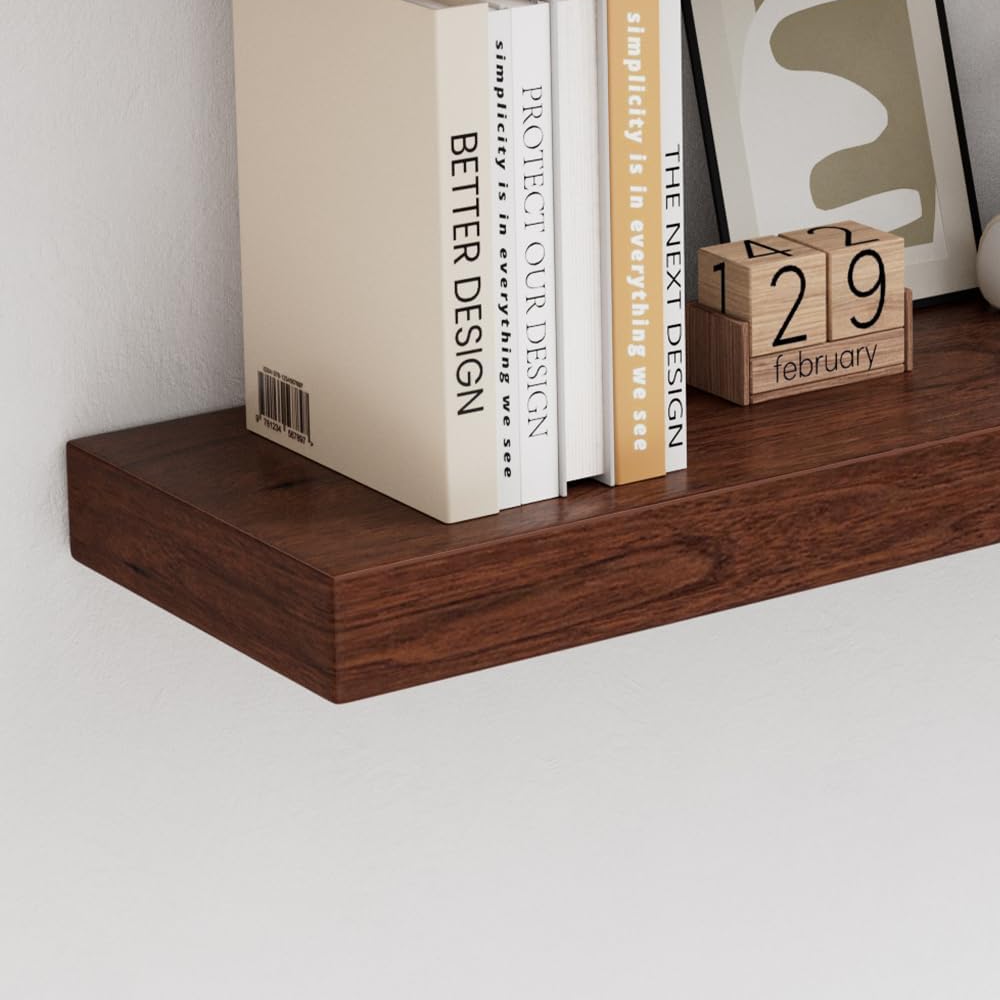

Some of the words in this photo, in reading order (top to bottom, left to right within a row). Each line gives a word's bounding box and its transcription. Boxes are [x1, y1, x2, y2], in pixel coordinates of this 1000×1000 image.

[494, 40, 507, 170] simplicity
[624, 12, 646, 143] simplicity
[498, 181, 508, 201] is
[522, 86, 546, 233] PROTECT
[629, 153, 648, 175] is
[665, 144, 681, 210] THE
[450, 132, 481, 265] BETTER
[499, 213, 509, 235] in
[629, 185, 648, 209] in
[525, 241, 546, 315] OUR
[626, 219, 649, 358] everything
[666, 222, 682, 309] NEXT
[454, 276, 484, 416] DESIGN
[498, 247, 512, 384] everything
[526, 322, 548, 439] DESIGN
[631, 366, 648, 400] we
[667, 323, 684, 448] DESIGN
[774, 343, 878, 383] february
[501, 395, 511, 426] we
[632, 410, 648, 451] see
[503, 438, 512, 478] see
